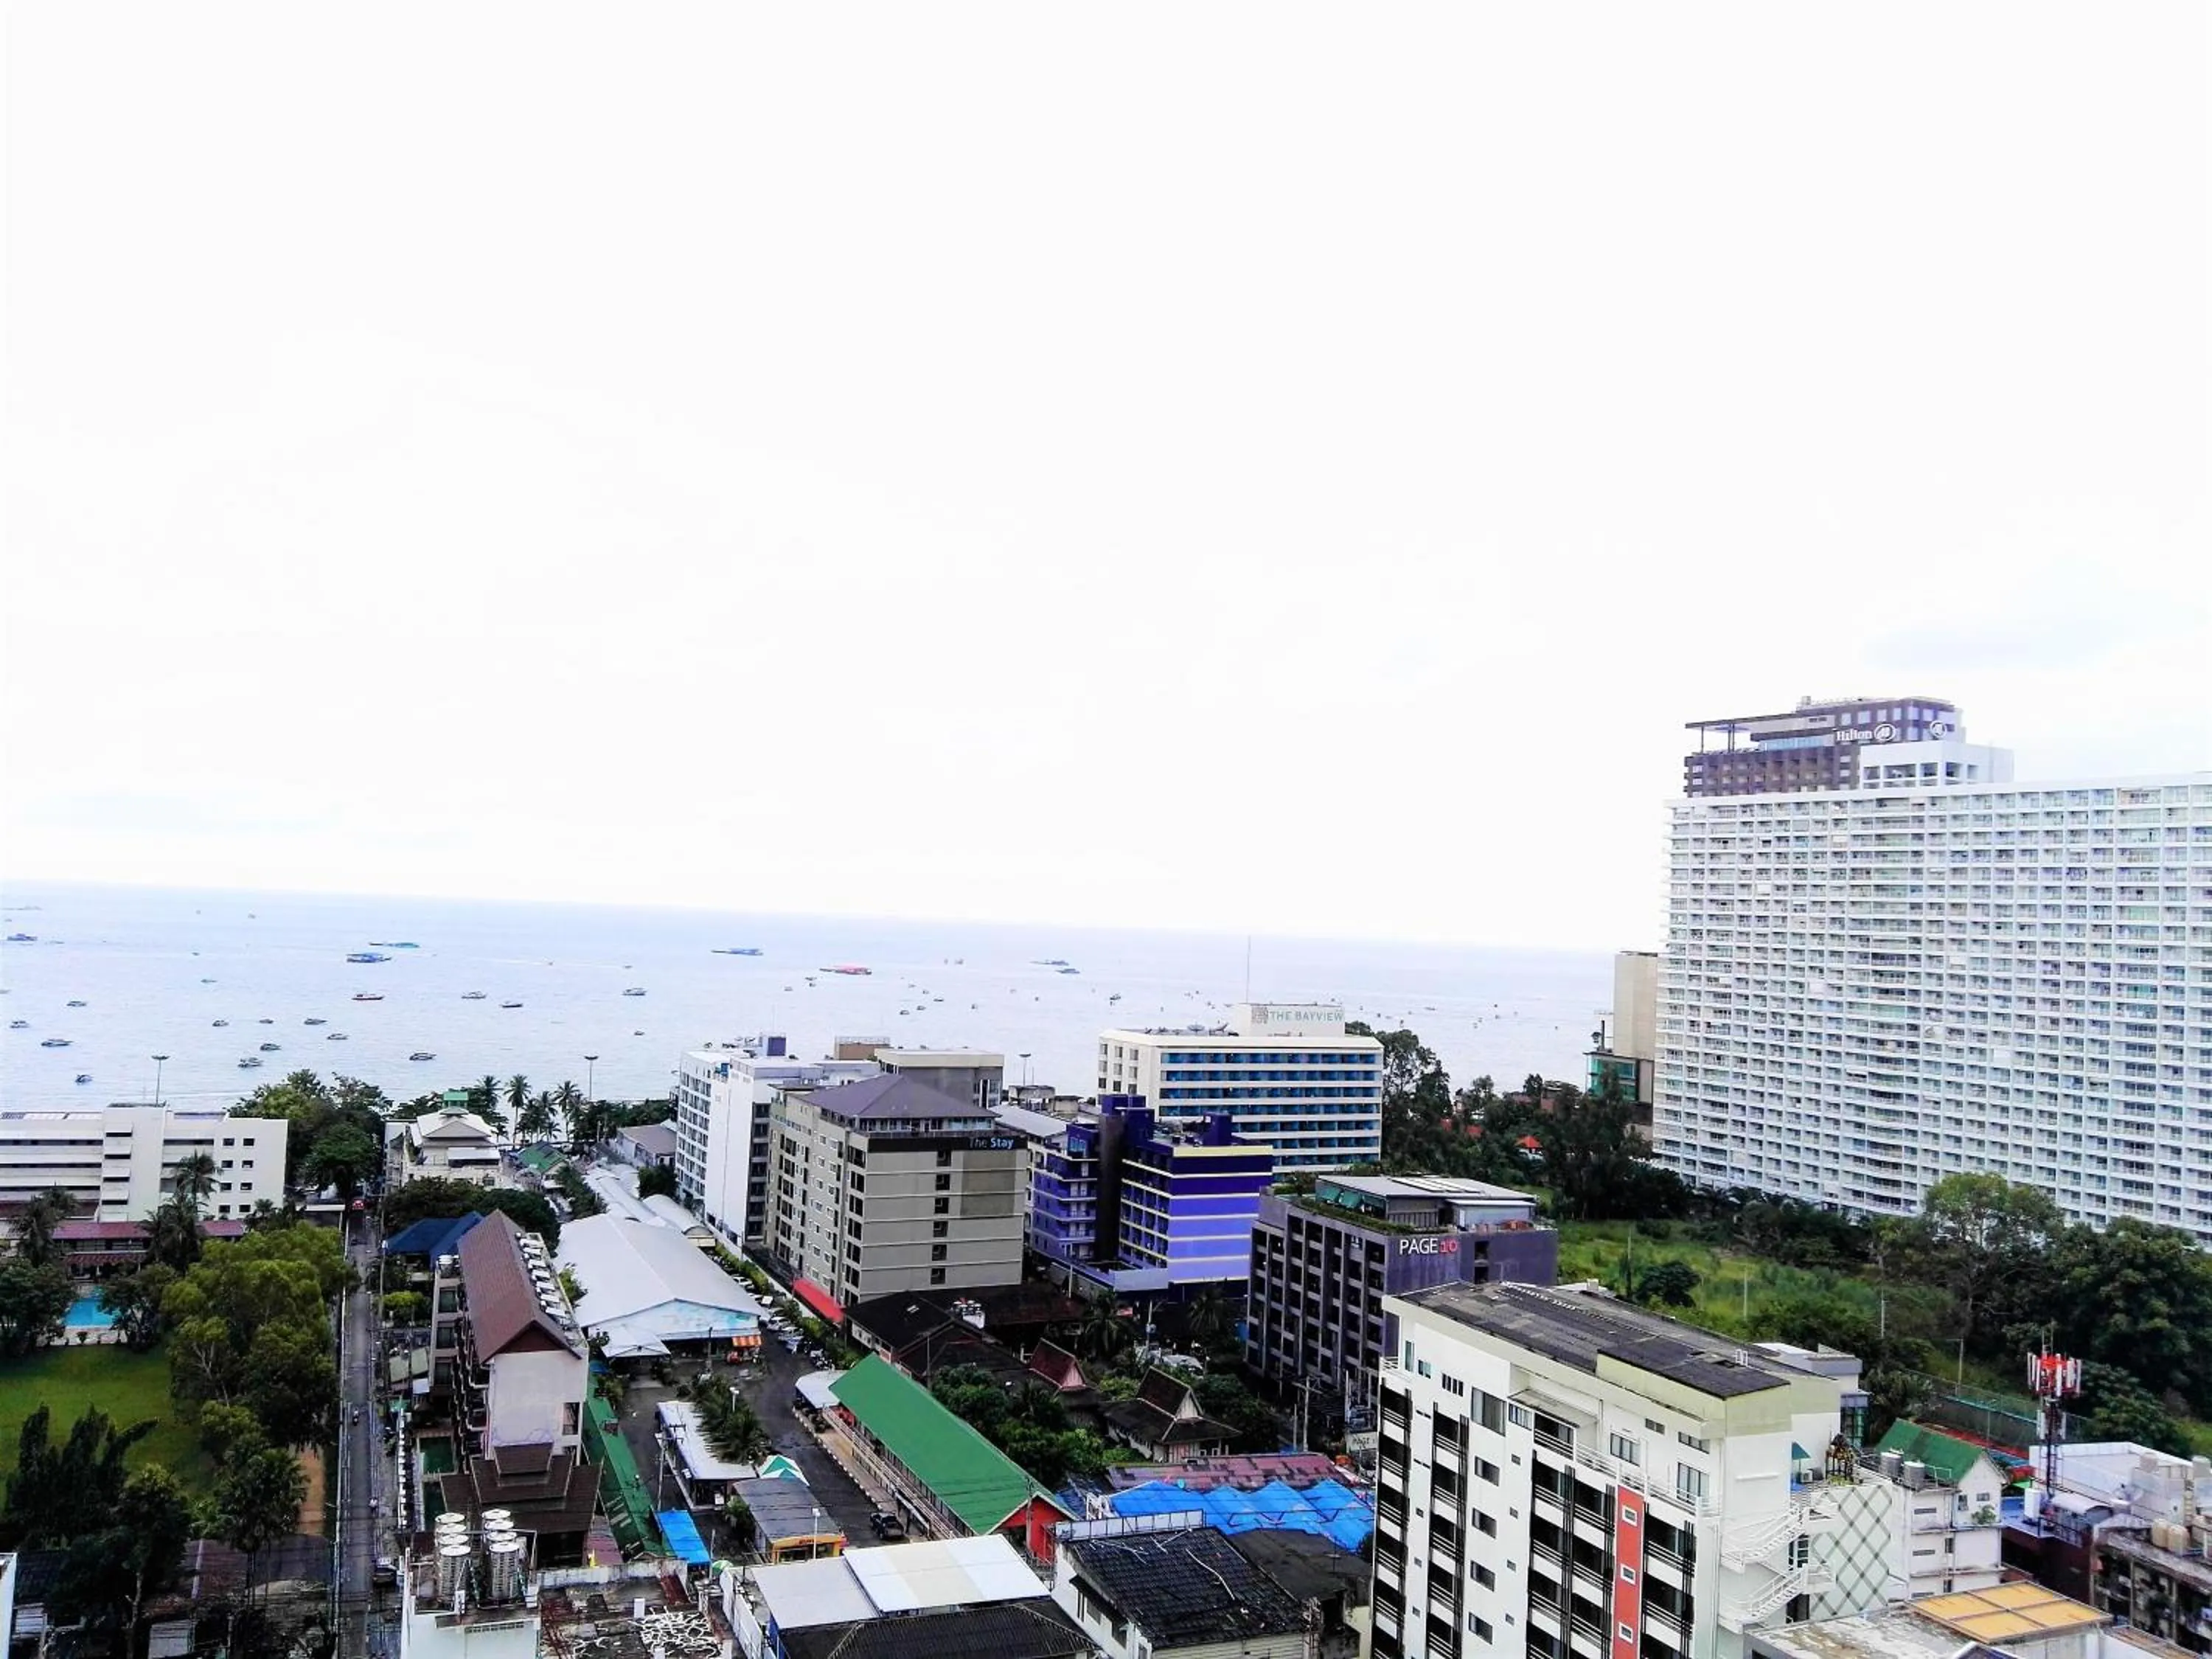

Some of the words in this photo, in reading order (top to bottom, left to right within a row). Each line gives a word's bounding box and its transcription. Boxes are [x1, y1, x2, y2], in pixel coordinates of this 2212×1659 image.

[1837, 728, 1872, 740] Hilton
[1270, 1011, 1292, 1020] THE
[1295, 1011, 1341, 1021] BAYVIEW
[969, 1138, 987, 1148] The
[990, 1138, 1014, 1150] Stay
